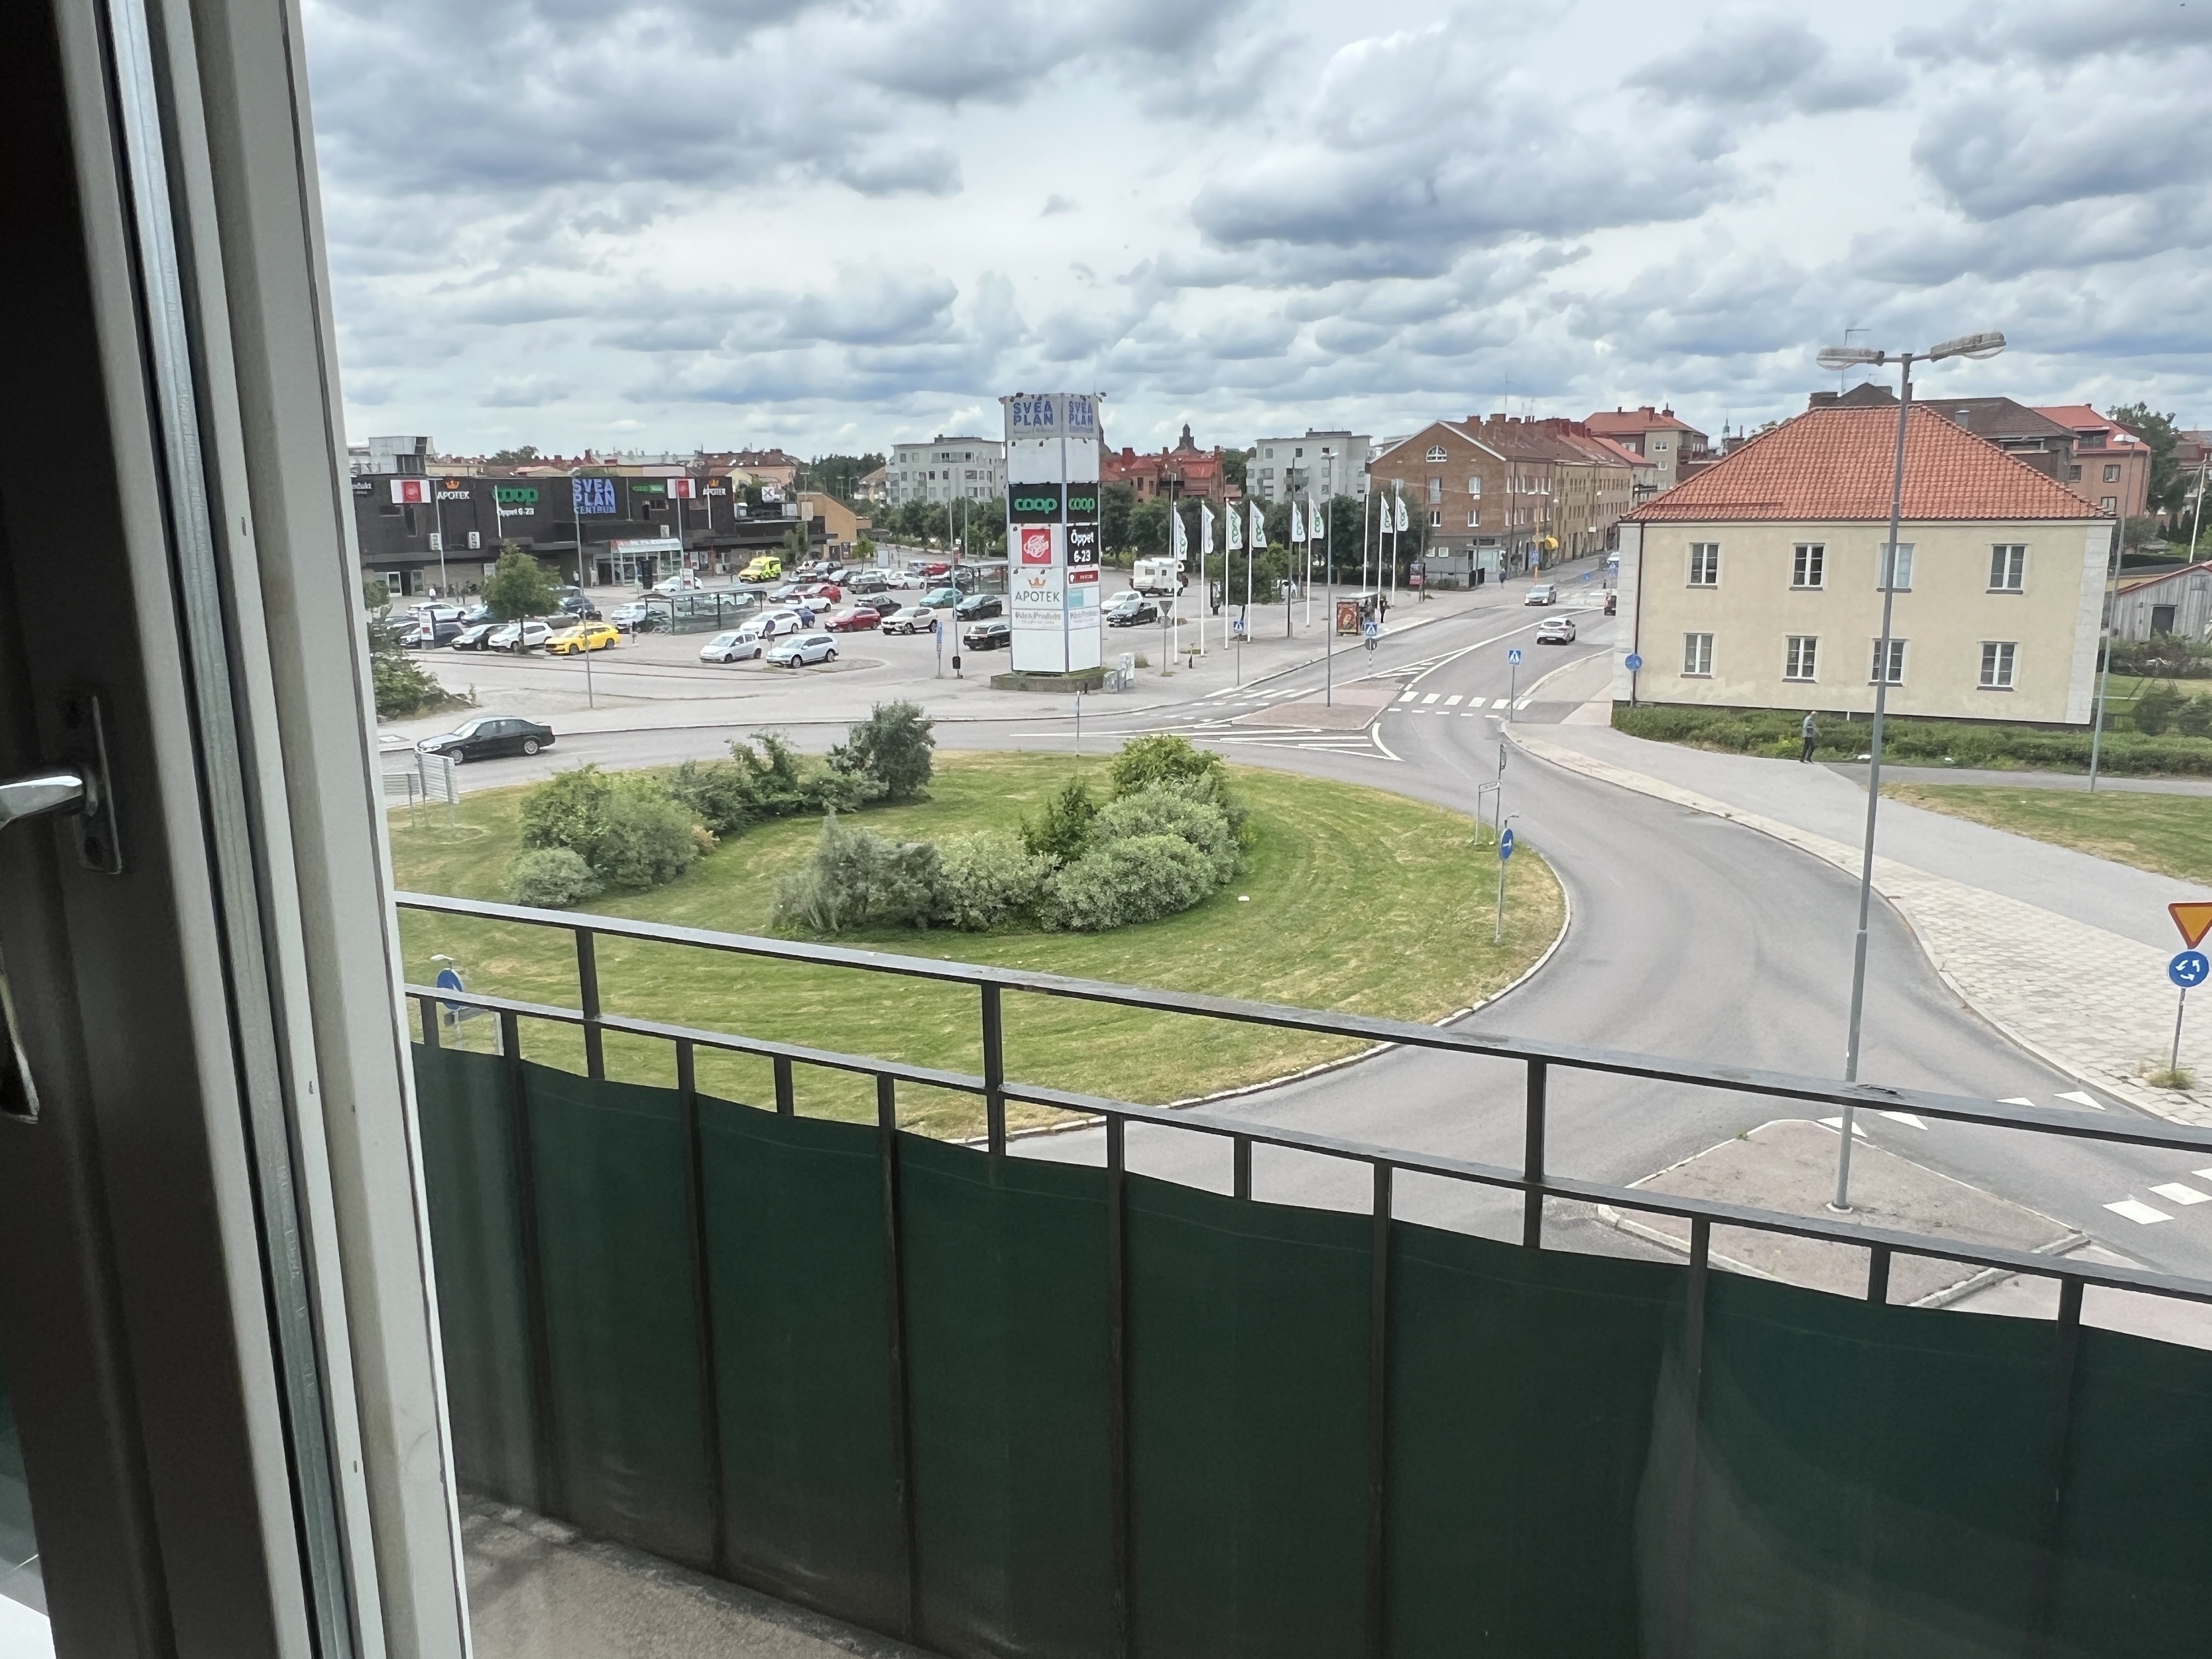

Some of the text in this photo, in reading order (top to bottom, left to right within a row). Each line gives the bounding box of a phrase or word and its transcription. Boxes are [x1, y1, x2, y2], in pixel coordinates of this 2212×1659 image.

[1013, 401, 1053, 414] SVEA
[1069, 401, 1093, 414] SVEA
[1013, 414, 1053, 426] PLAN
[1069, 414, 1093, 426] PLAN
[572, 478, 614, 493] SVEA
[437, 491, 470, 500] APOTEK
[573, 492, 616, 506] PLAN
[1014, 498, 1058, 514] coop
[1069, 498, 1096, 514] coop
[1071, 529, 1094, 548] Öppet
[1074, 549, 1091, 563] 6-23
[1015, 590, 1060, 602] APOTEK
